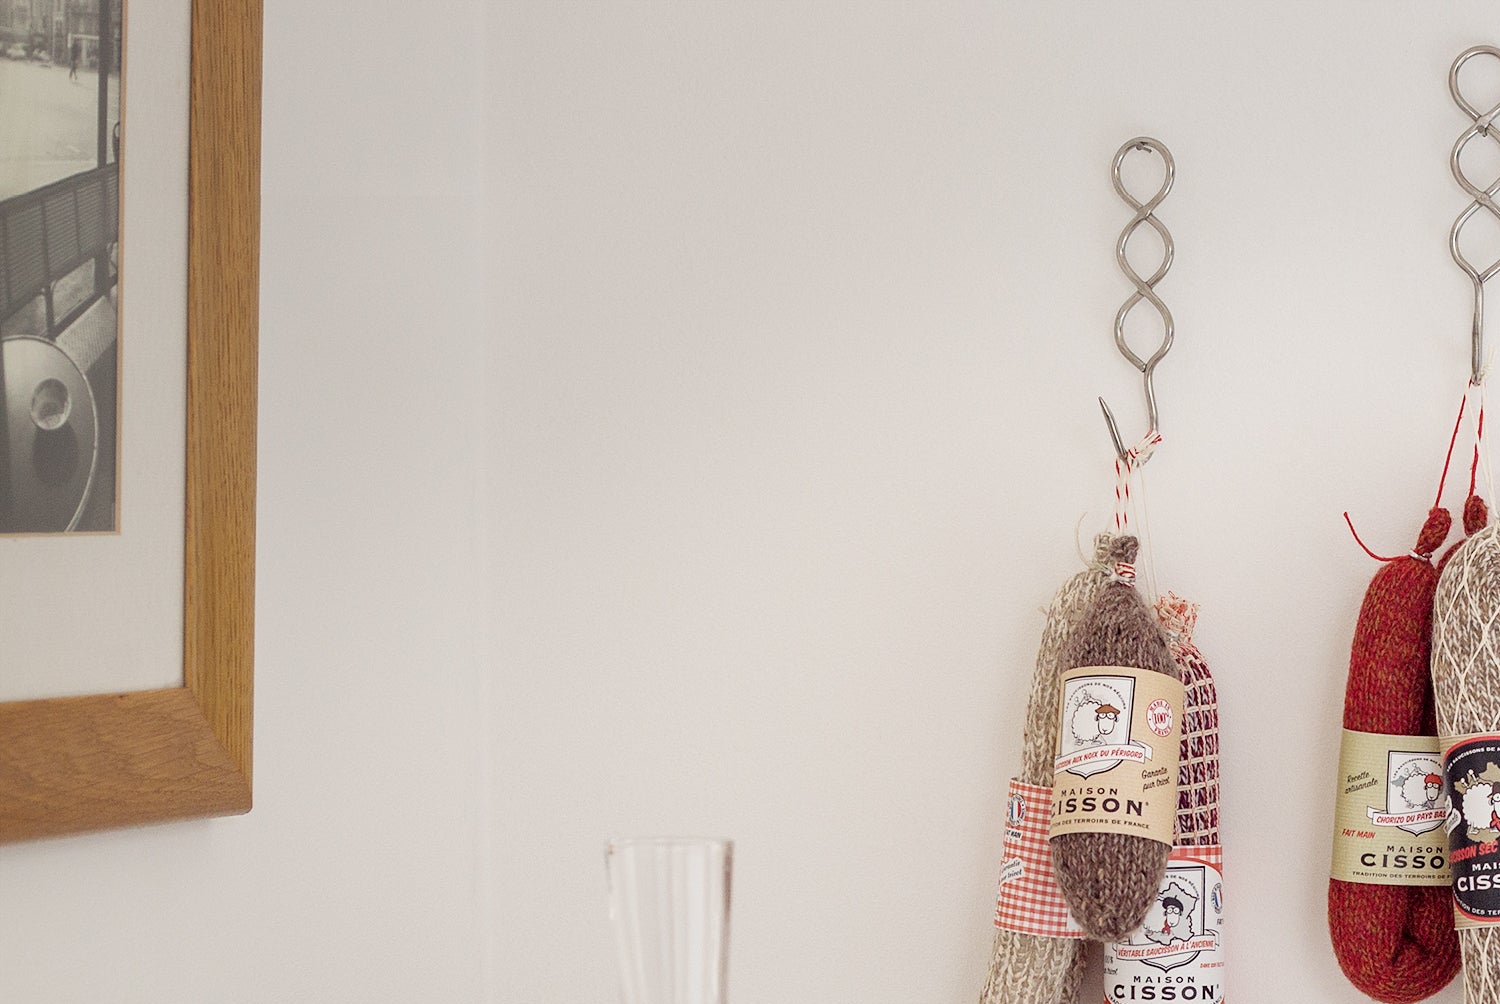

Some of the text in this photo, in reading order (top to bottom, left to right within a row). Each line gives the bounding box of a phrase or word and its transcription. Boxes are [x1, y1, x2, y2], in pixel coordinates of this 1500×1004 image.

[1072, 755, 1083, 765] AUX
[1083, 750, 1099, 760] NOIX
[1100, 749, 1109, 757] DU
[1111, 747, 1144, 760] PÉRIGORD
[1452, 746, 1486, 764] SAUCISSONS
[1346, 771, 1370, 784] Recette
[1061, 787, 1118, 797] MAISON
[1376, 815, 1405, 824] CHORIZO
[1405, 814, 1416, 823] DU
[1416, 811, 1434, 822] PAYS
[1123, 820, 1150, 830] FRANCE
[1341, 828, 1376, 839] FAIT MAIN
[1386, 845, 1443, 854] MAISON
[1478, 840, 1500, 856] SEC
[1360, 852, 1451, 870] CISSO
[1352, 870, 1388, 878] TRADITION
[1471, 907, 1486, 916] DES
[1117, 947, 1145, 958] VÉRITABLE
[1146, 944, 1180, 957] SAUCISSON
[1133, 975, 1196, 984] MAISON
